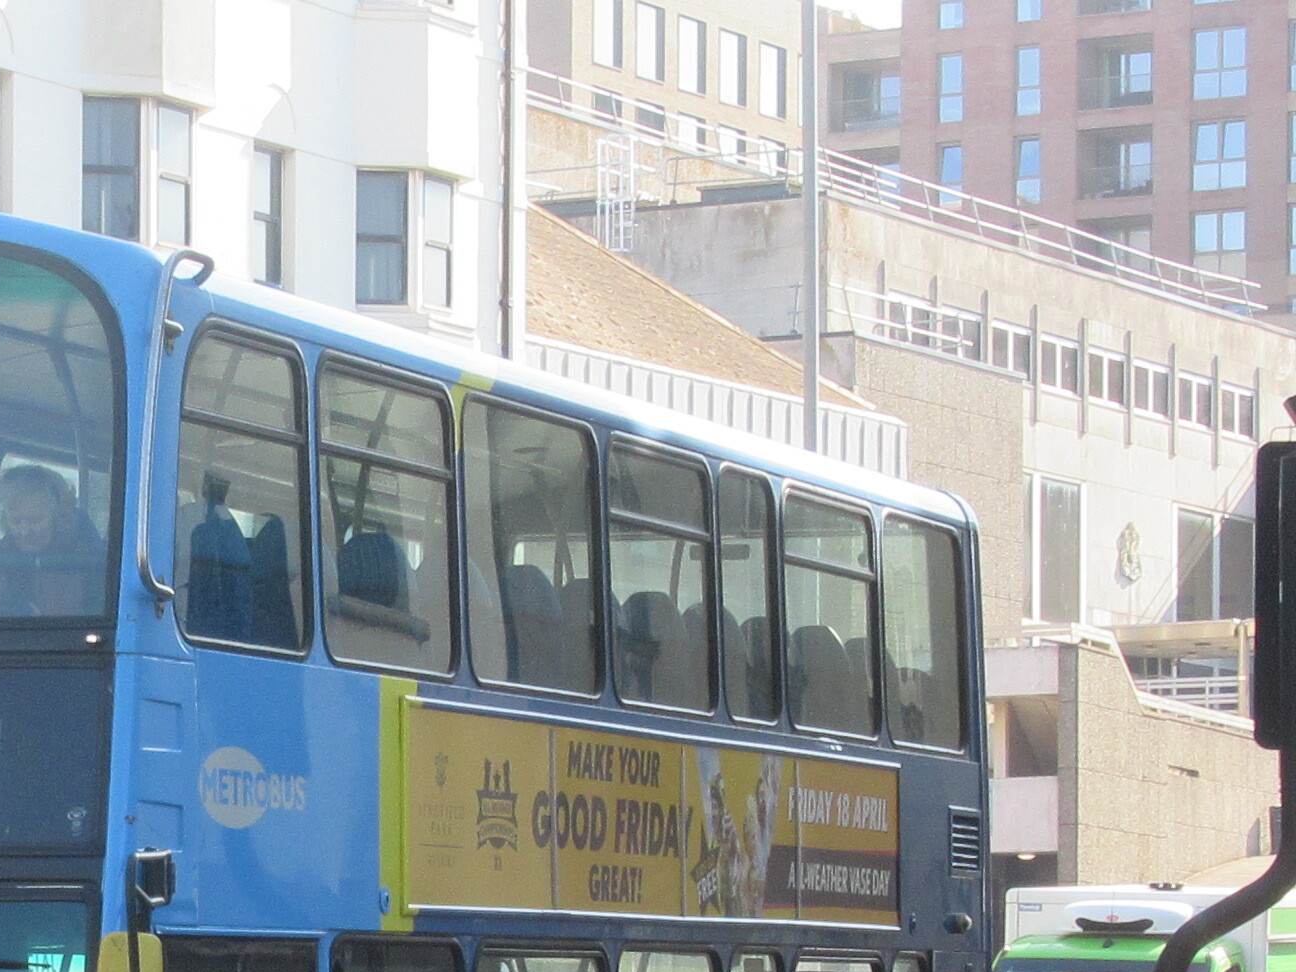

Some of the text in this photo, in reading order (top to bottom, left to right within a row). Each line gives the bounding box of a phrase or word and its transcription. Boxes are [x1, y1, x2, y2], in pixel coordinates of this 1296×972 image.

[567, 740, 661, 788] MAKE YOUR
[202, 766, 308, 812] METROBUS
[787, 786, 888, 832] FRIDAY 18 APRIL
[531, 790, 694, 859] GOOD FRIDAY
[589, 863, 642, 903] GREAT!
[787, 861, 849, 893] AL-WEATHER
[872, 869, 891, 896] DAY
